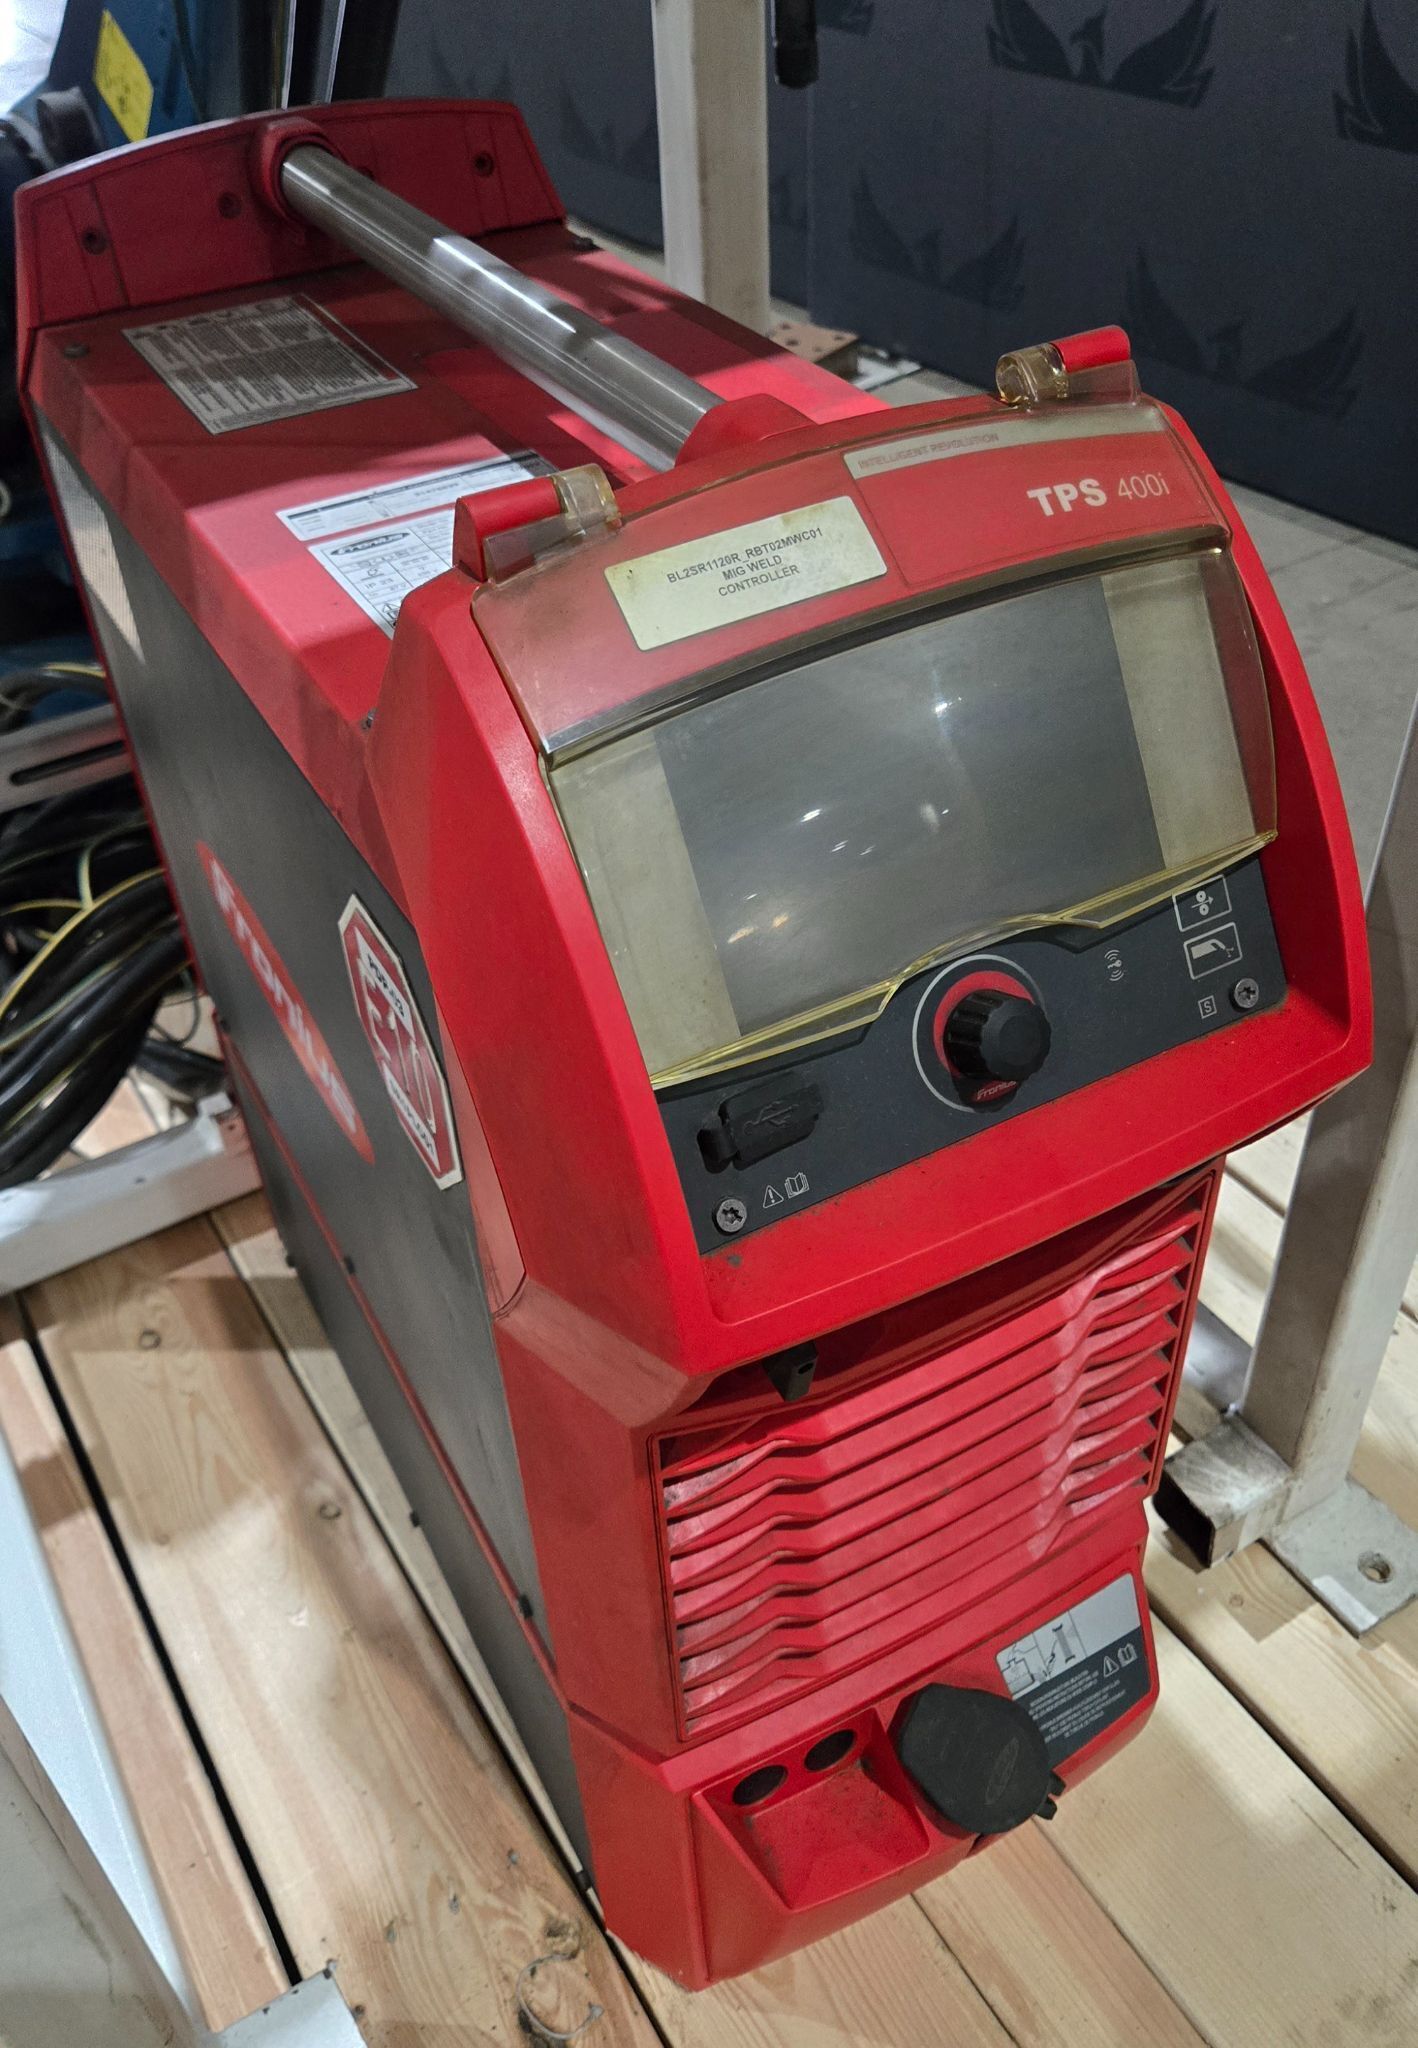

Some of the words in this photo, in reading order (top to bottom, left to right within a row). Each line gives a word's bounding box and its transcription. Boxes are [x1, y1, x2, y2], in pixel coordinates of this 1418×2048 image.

[857, 443, 931, 470] INTELLIGENT
[929, 431, 1000, 454] REVOLUTION
[1026, 478, 1108, 517] TPS
[1116, 472, 1170, 501] 400i
[718, 563, 801, 598] CONTROLLER
[722, 563, 747, 581] MIG
[749, 554, 783, 573] WELD
[1203, 1000, 1212, 1013] S
